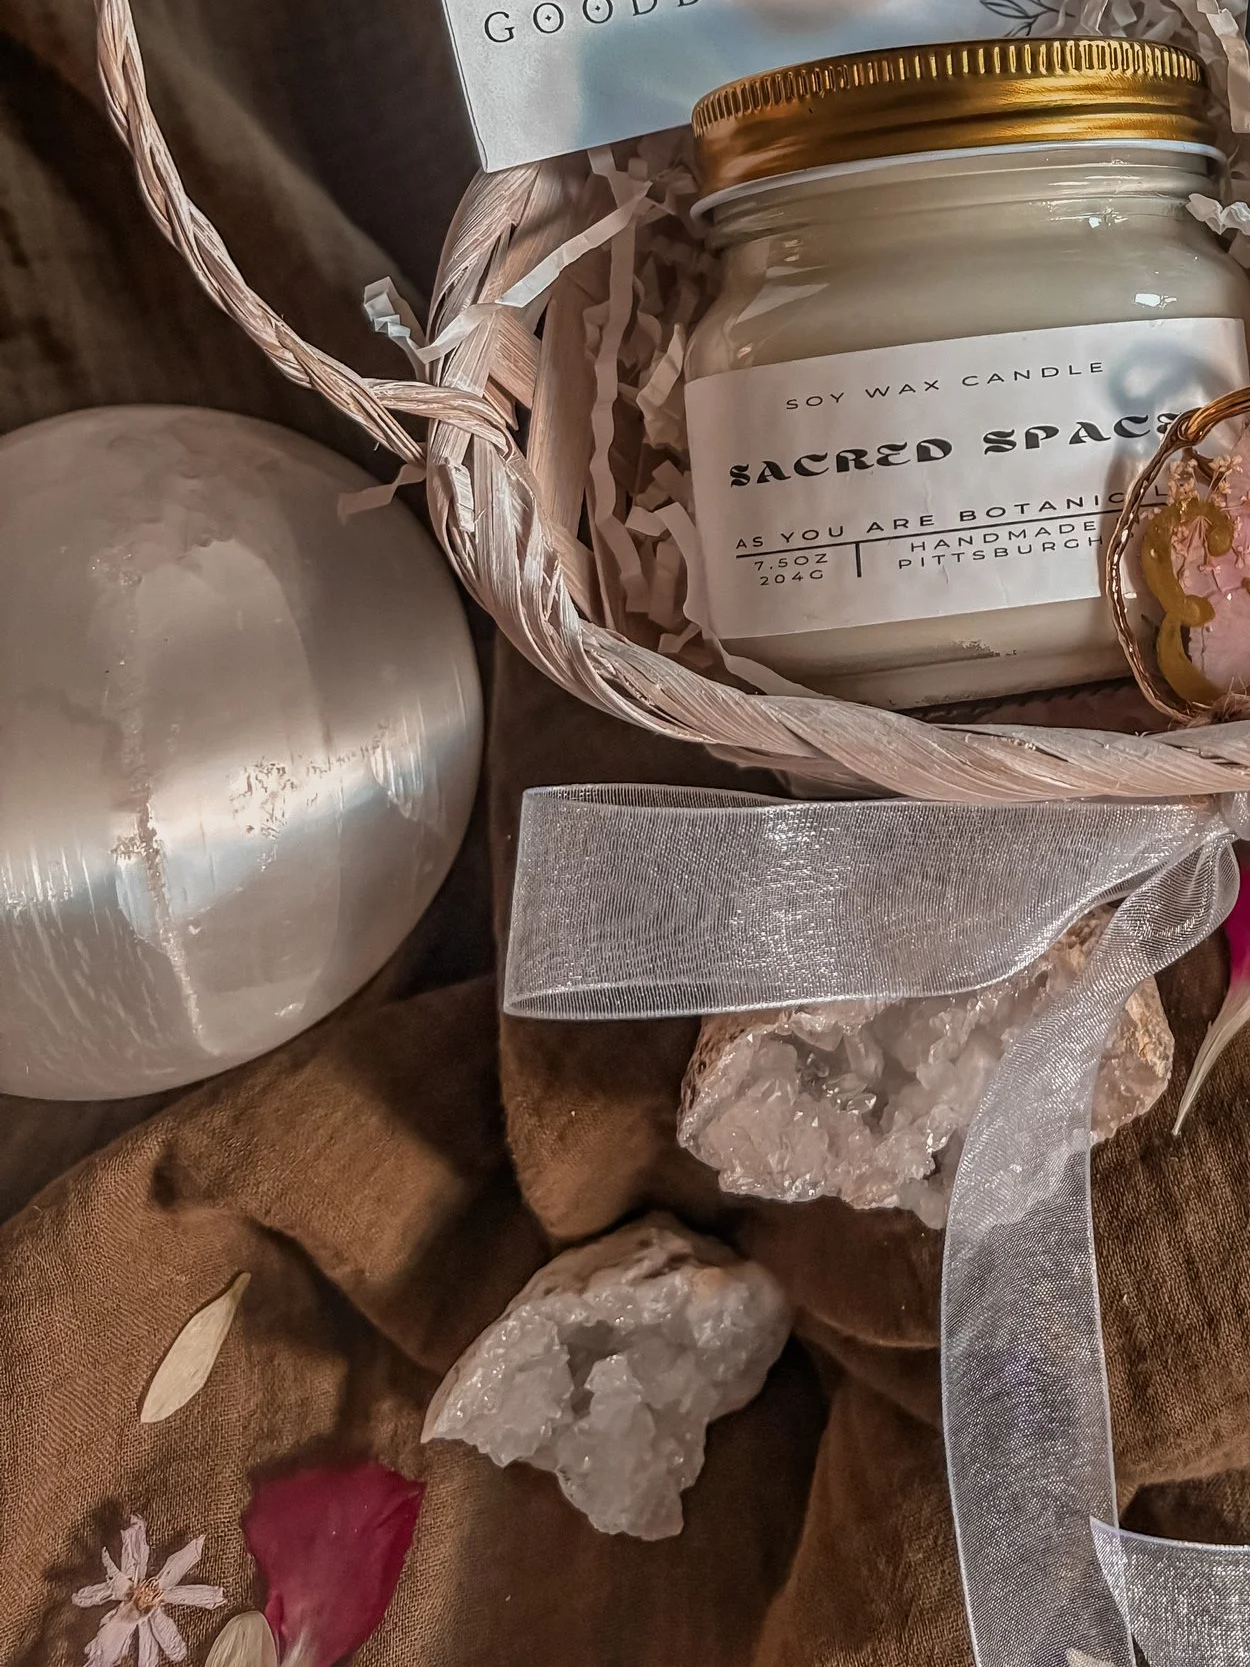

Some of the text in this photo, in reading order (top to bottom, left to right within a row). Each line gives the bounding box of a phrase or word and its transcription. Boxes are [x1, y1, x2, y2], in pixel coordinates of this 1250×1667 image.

[786, 362, 1103, 409] SOY WAX CANDLE
[730, 439, 952, 487] SACRED
[736, 536, 764, 550] AS
[781, 525, 845, 542] YOU
[866, 515, 935, 533] ARE
[911, 521, 1096, 552] HANDMADE
[899, 535, 1103, 569] PITTSBURGH
[760, 568, 824, 586] 204G
